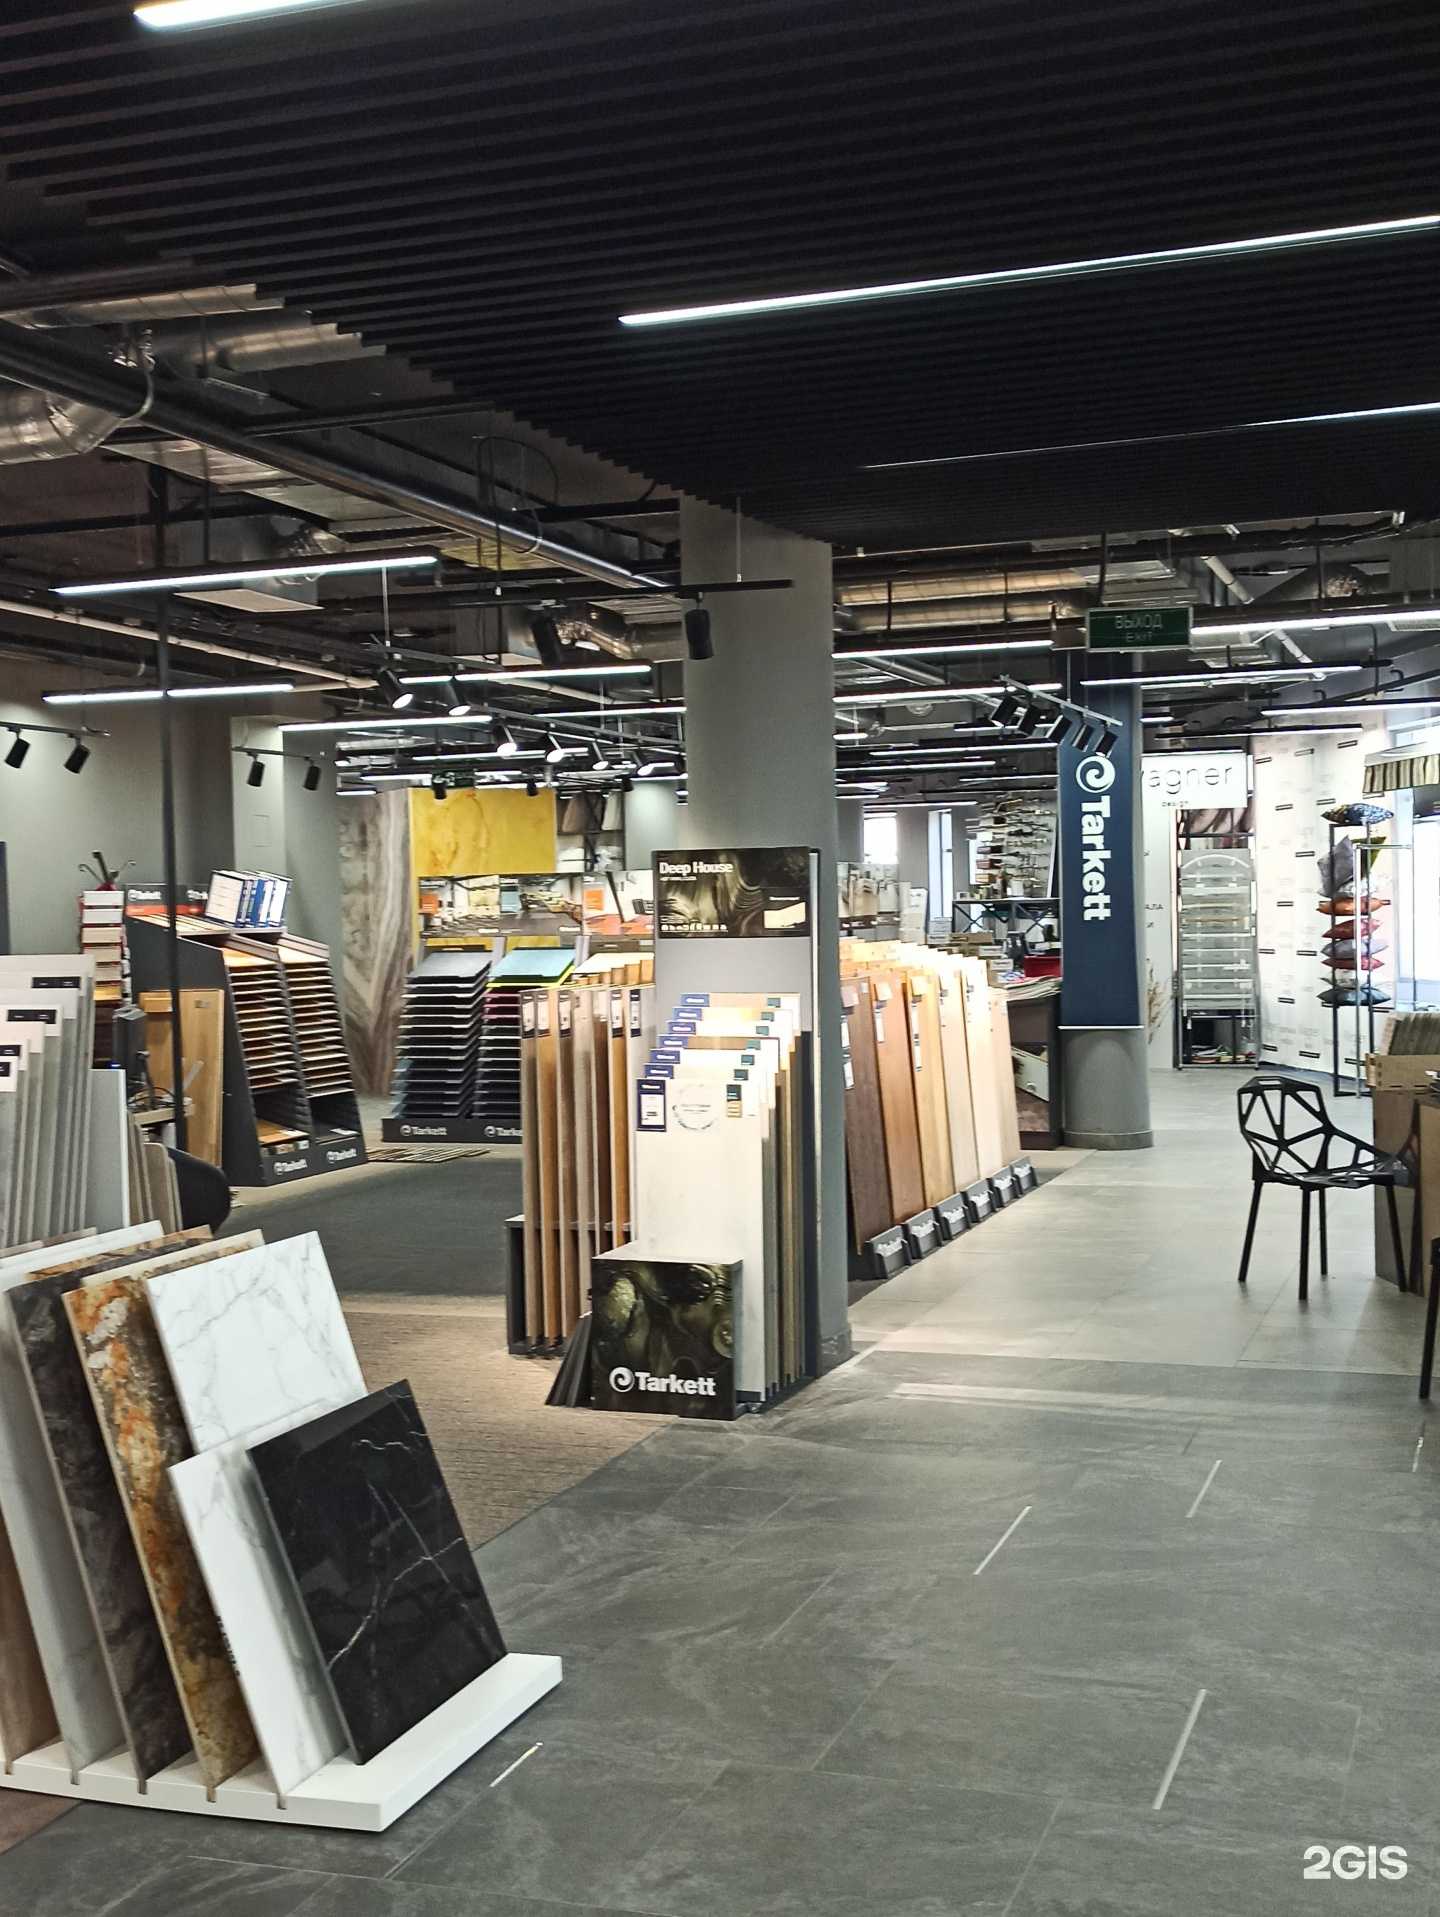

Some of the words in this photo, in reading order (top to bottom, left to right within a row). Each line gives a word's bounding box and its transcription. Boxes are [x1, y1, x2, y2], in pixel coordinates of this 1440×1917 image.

[1142, 767, 1233, 795] agner
[659, 862, 692, 876] Deep
[693, 861, 734, 874] House
[1081, 795, 1112, 921] Tarkett
[412, 1126, 447, 1136] Tarkett
[634, 1371, 716, 1396] Tarkett
